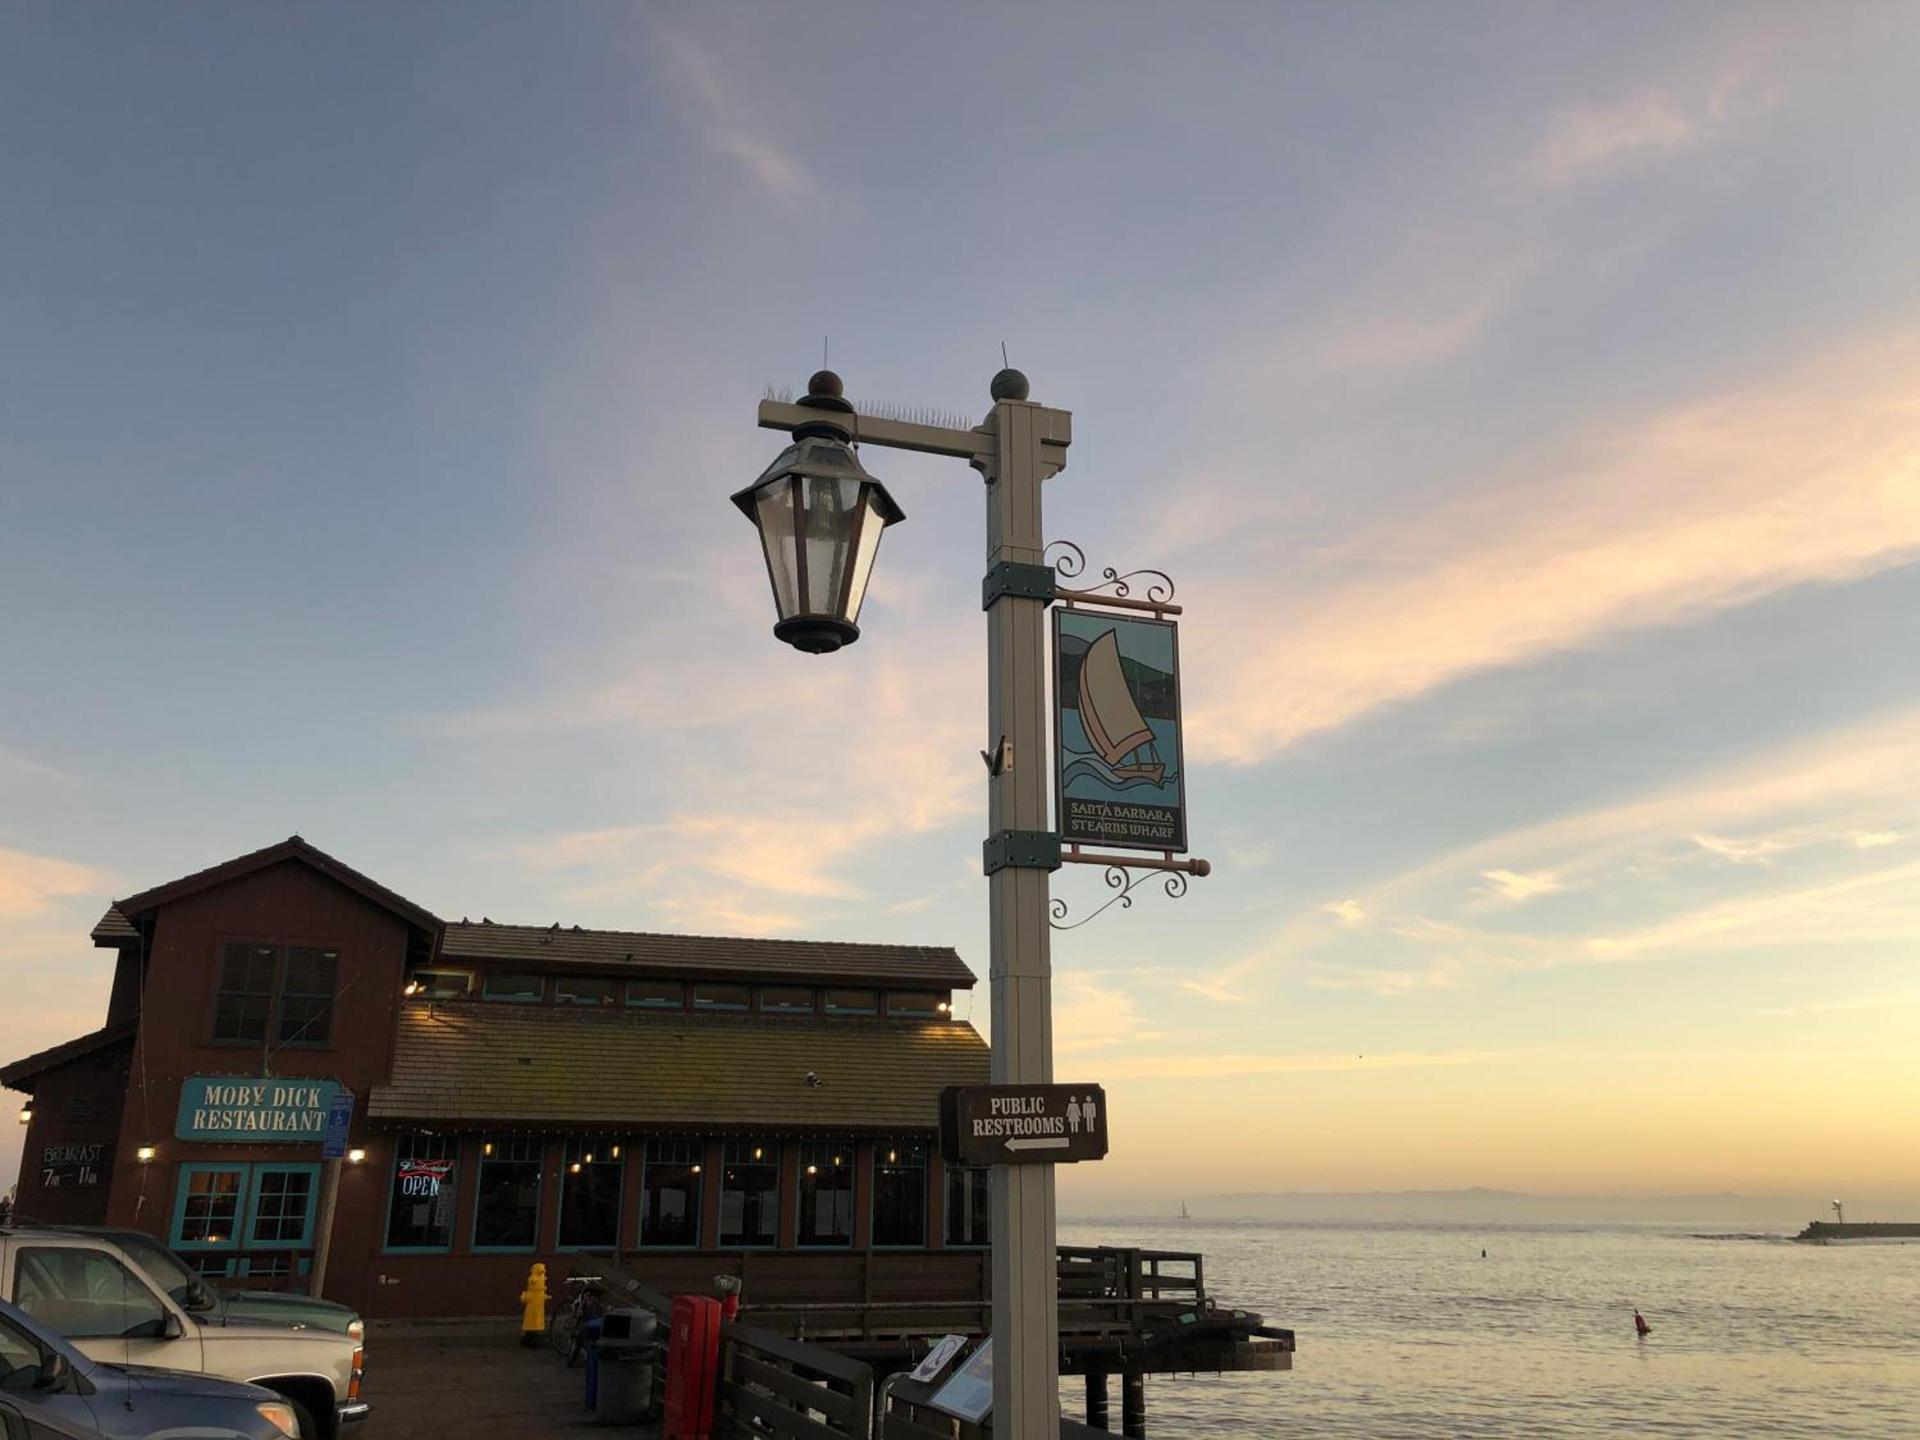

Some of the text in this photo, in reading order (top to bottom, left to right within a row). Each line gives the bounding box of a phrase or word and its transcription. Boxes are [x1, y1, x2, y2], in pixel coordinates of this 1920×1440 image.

[1070, 802, 1174, 821] SANTA BARBARA
[1071, 819, 1175, 838] STEARNS WHARF
[204, 1085, 266, 1107] MOBY
[272, 1087, 321, 1108] DICK
[991, 1097, 1045, 1115] PUBLIC
[192, 1109, 326, 1131] RESTAURANT
[972, 1117, 1065, 1136] RESTROOMS
[43, 1144, 104, 1162] BREAKFAST
[402, 1176, 440, 1196] OPEN
